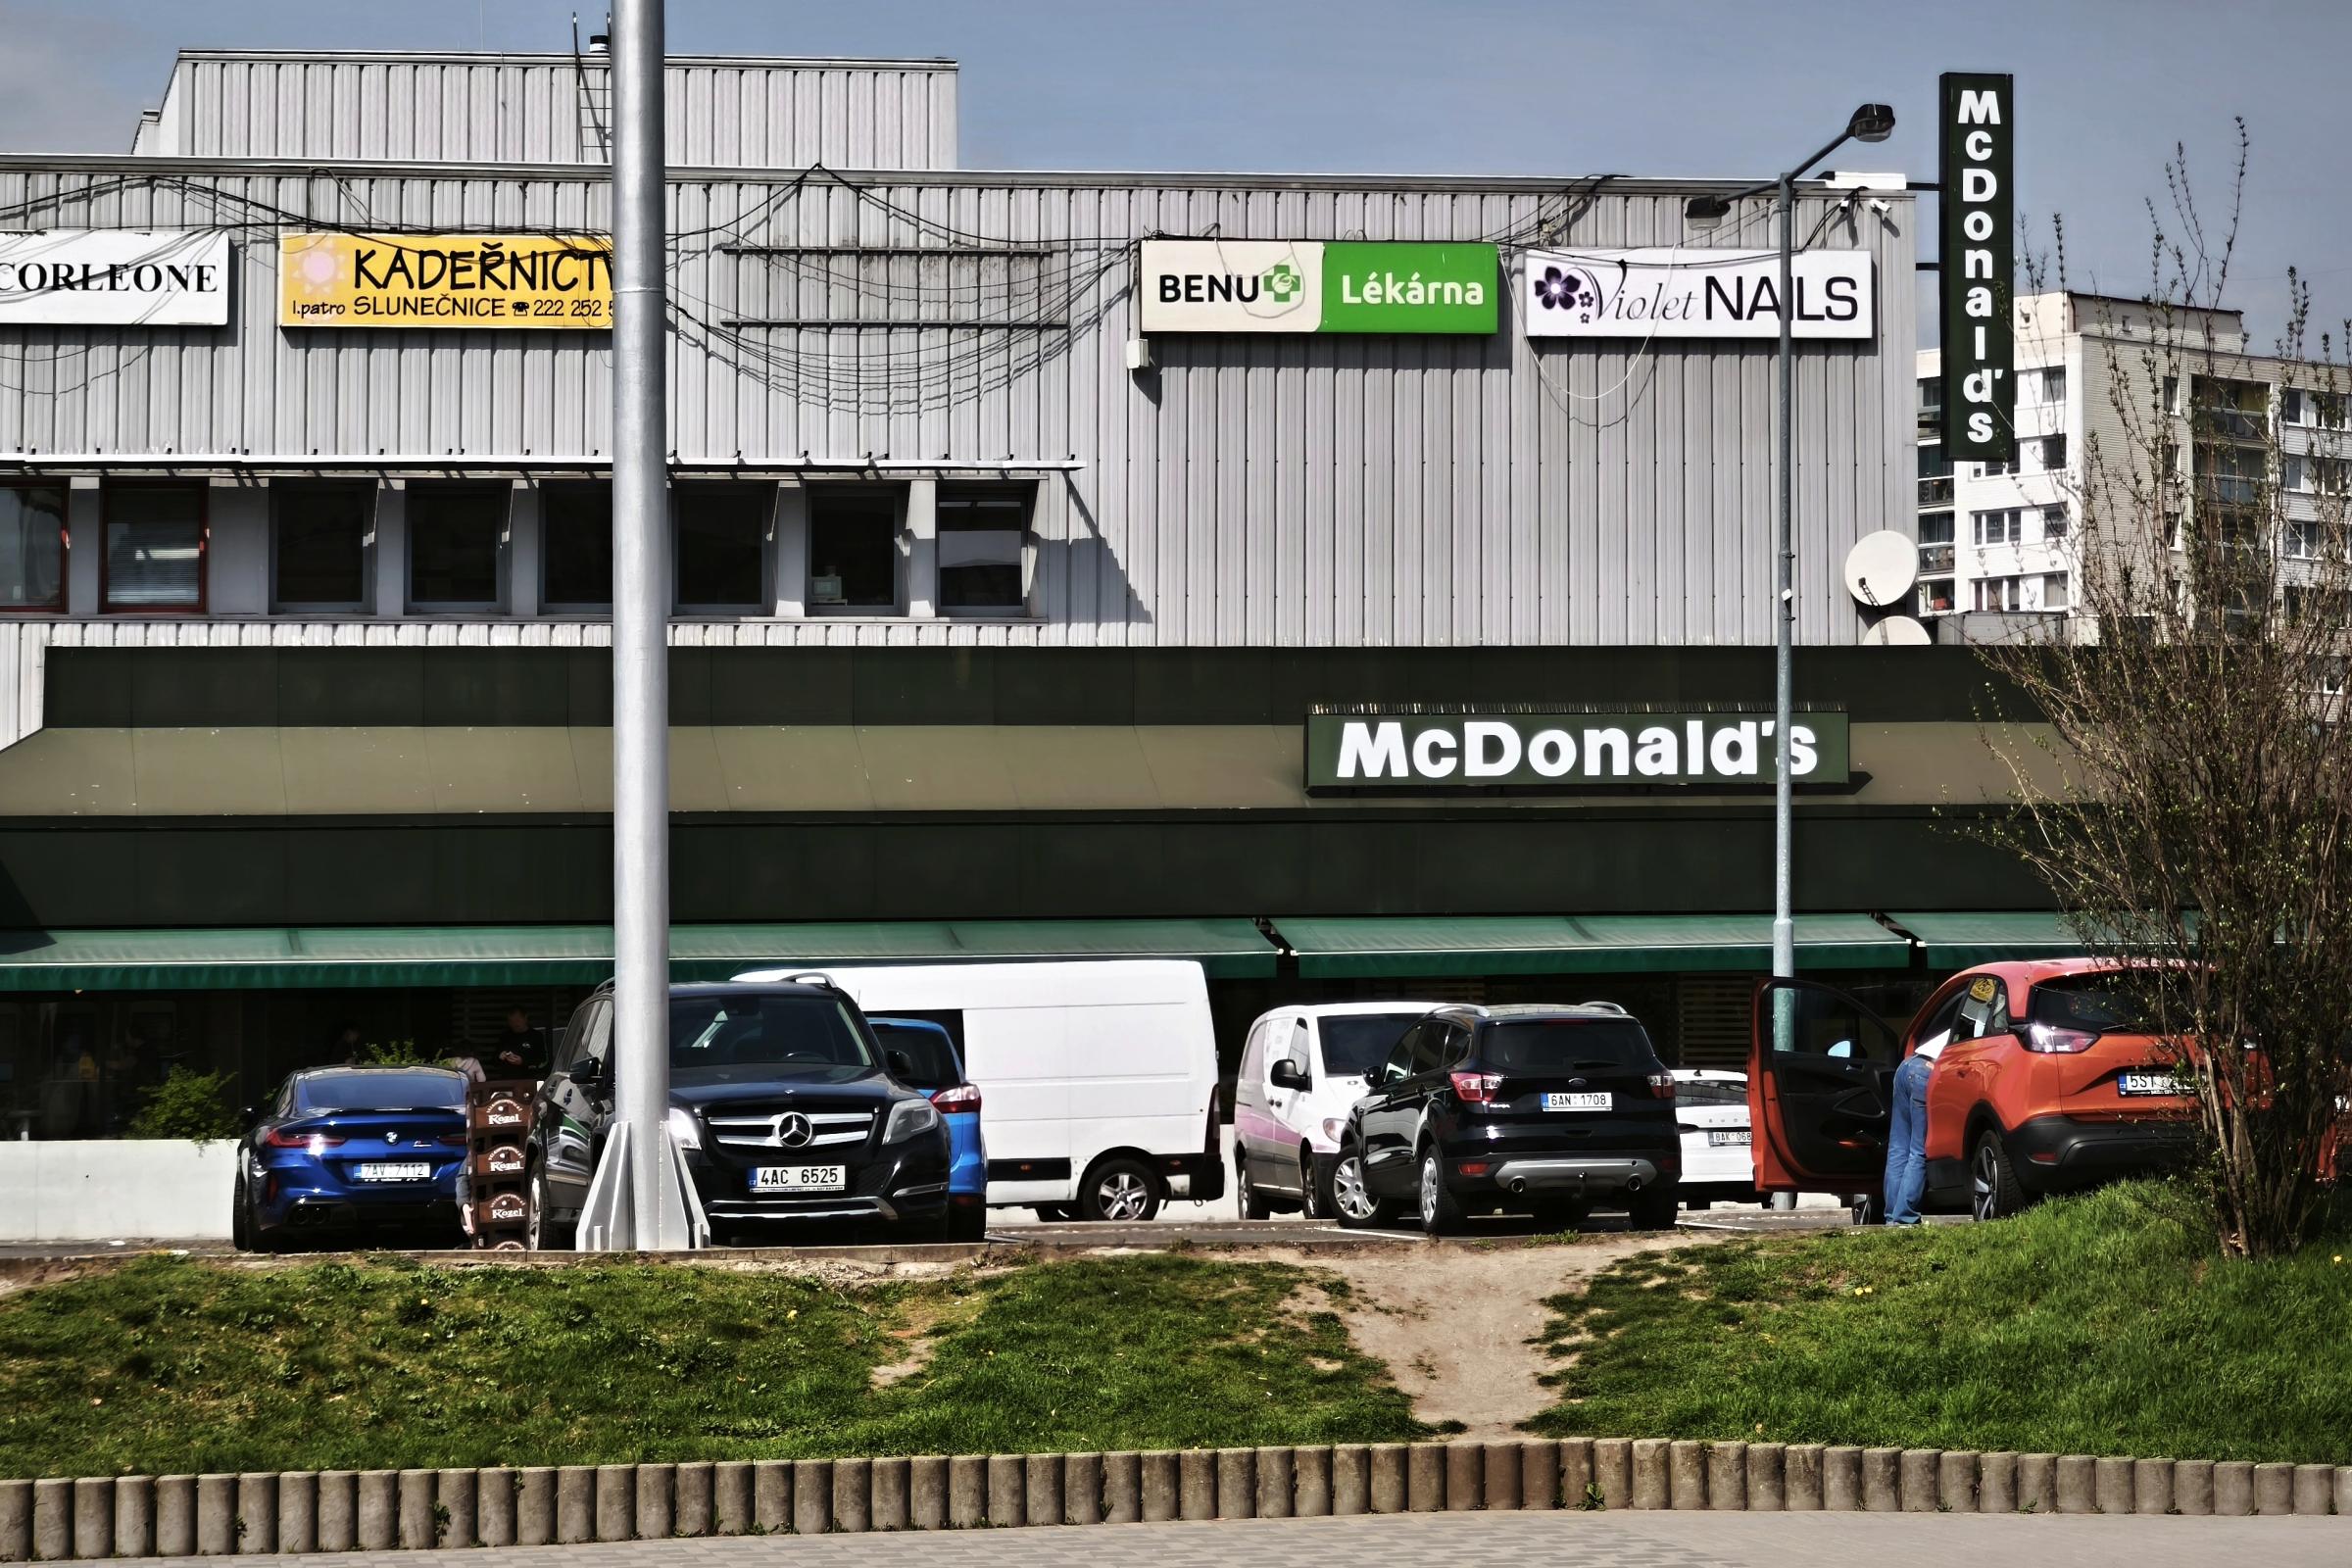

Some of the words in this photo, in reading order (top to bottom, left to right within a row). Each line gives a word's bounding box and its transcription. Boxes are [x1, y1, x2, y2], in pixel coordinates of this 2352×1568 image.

[1957, 90, 2004, 444] McDonald's
[1159, 274, 1259, 303] BENU
[1342, 271, 1484, 305] Lékárna
[1570, 259, 1698, 321] Violet
[1705, 275, 1858, 321] NALS
[354, 294, 506, 318] SLUNEČNICE
[534, 300, 564, 317] 222
[570, 300, 603, 317] 252
[1336, 720, 1818, 778] McDonald's
[1551, 1095, 1572, 1105] 6AN
[1582, 1094, 1606, 1105] 1708
[488, 1113, 522, 1125] Kozel
[1736, 1132, 1752, 1141] 068
[365, 1163, 386, 1177] 7AV
[396, 1163, 424, 1176] 7112
[490, 1160, 524, 1172] Kozel
[760, 1169, 789, 1186] 4AC
[801, 1167, 838, 1184] 6525
[492, 1207, 526, 1219] Kozel
